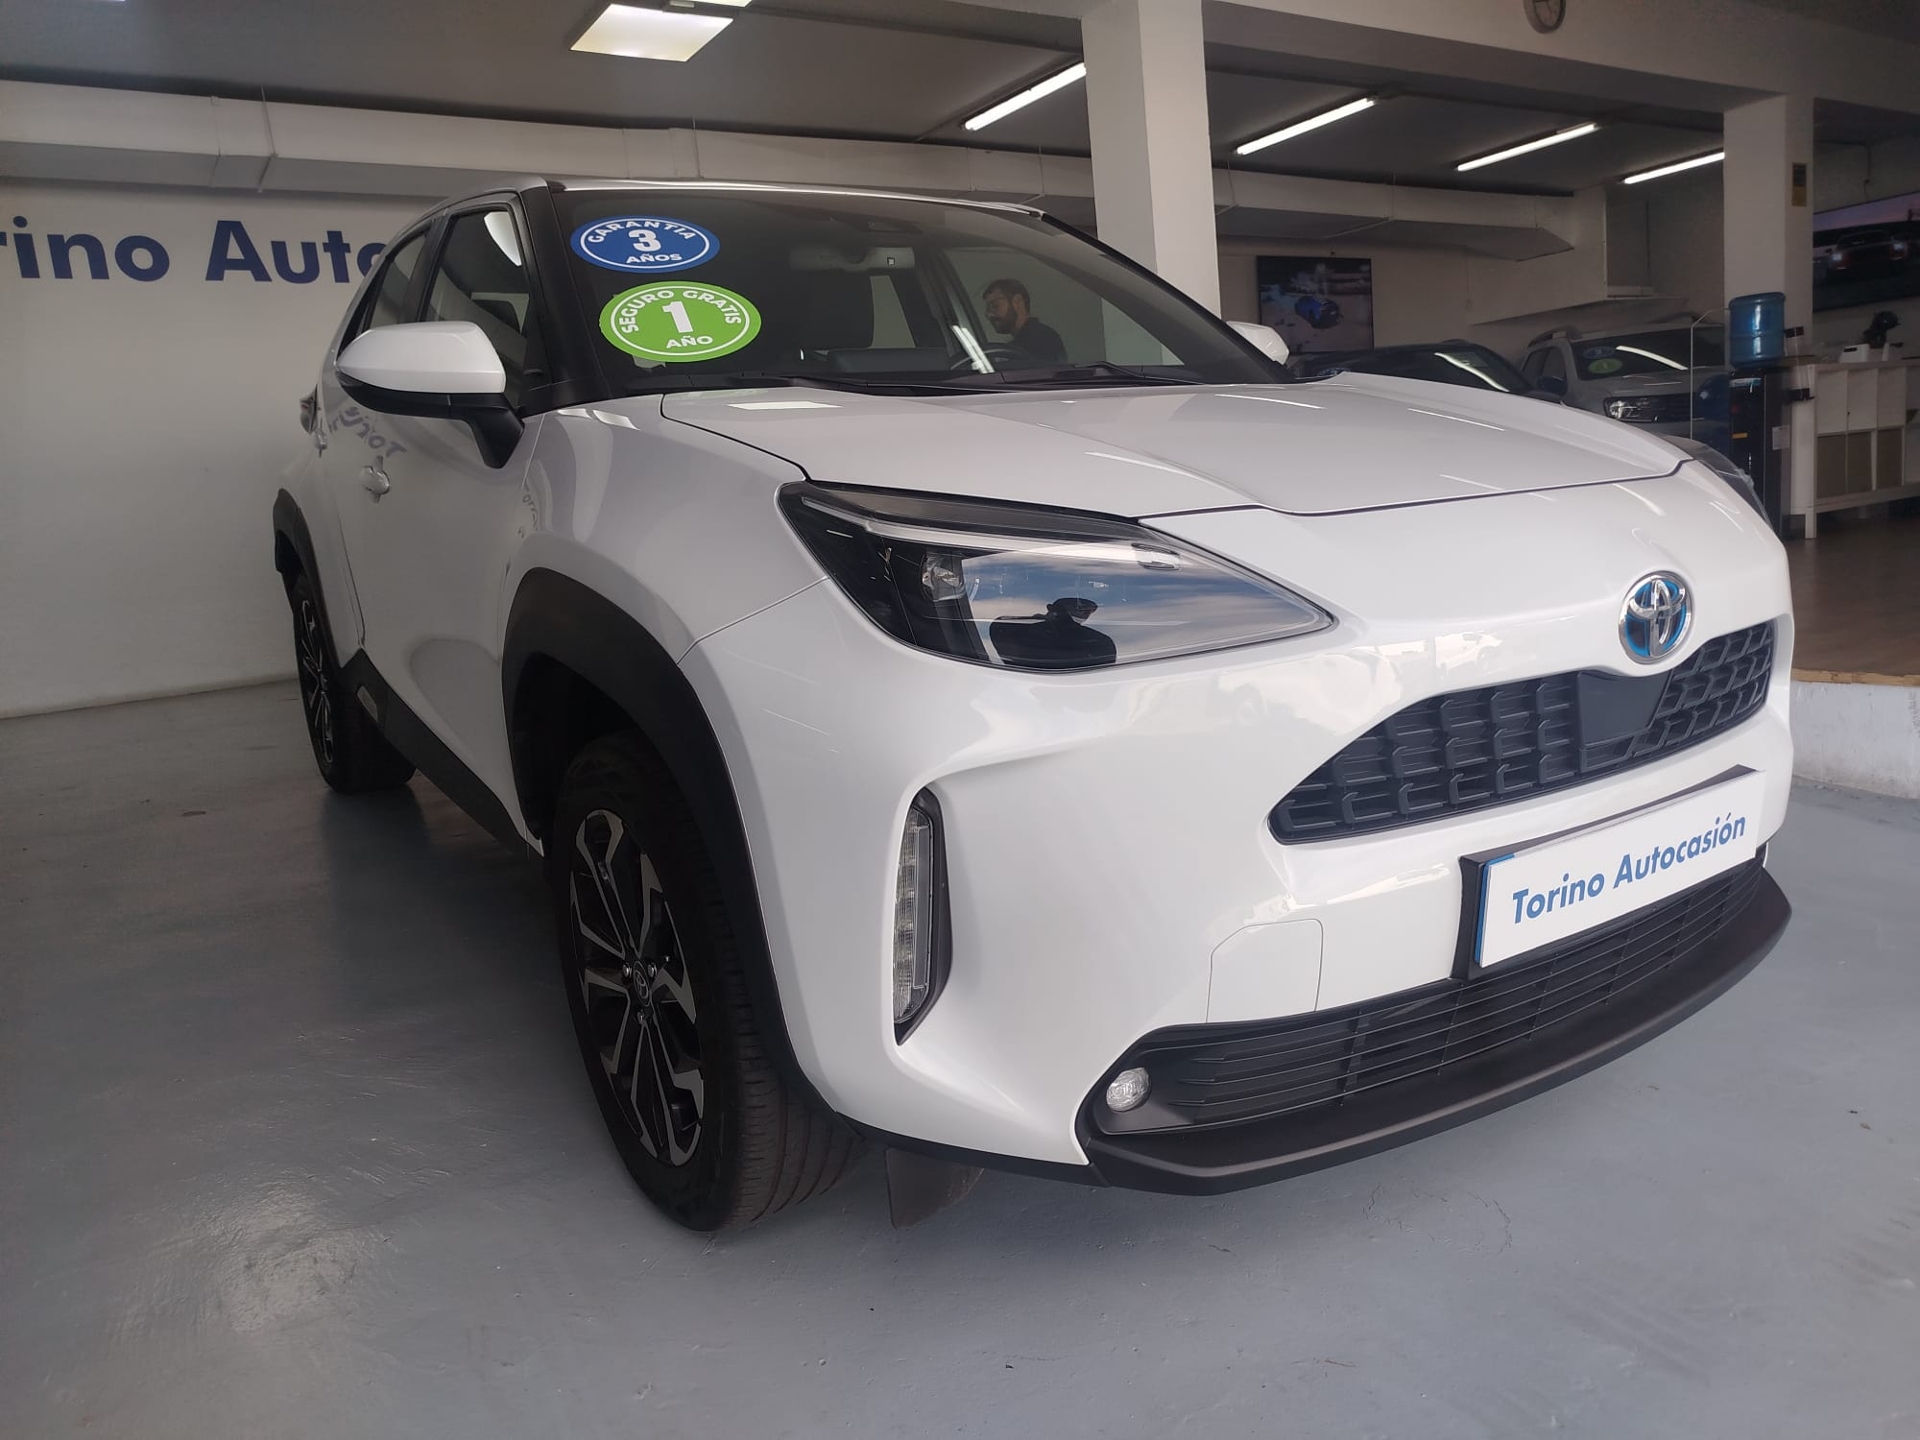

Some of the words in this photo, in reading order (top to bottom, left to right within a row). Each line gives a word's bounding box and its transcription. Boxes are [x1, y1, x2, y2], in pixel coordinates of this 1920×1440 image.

[0, 216, 170, 281] ino
[629, 230, 662, 252] 3
[627, 254, 682, 264] AÑOS
[620, 291, 674, 333] SEGURO
[683, 291, 742, 324] GRATIS
[662, 301, 693, 333] 1
[667, 335, 713, 348] AÑO
[1513, 873, 1604, 924] Torino
[1613, 812, 1746, 888] Autocasión
